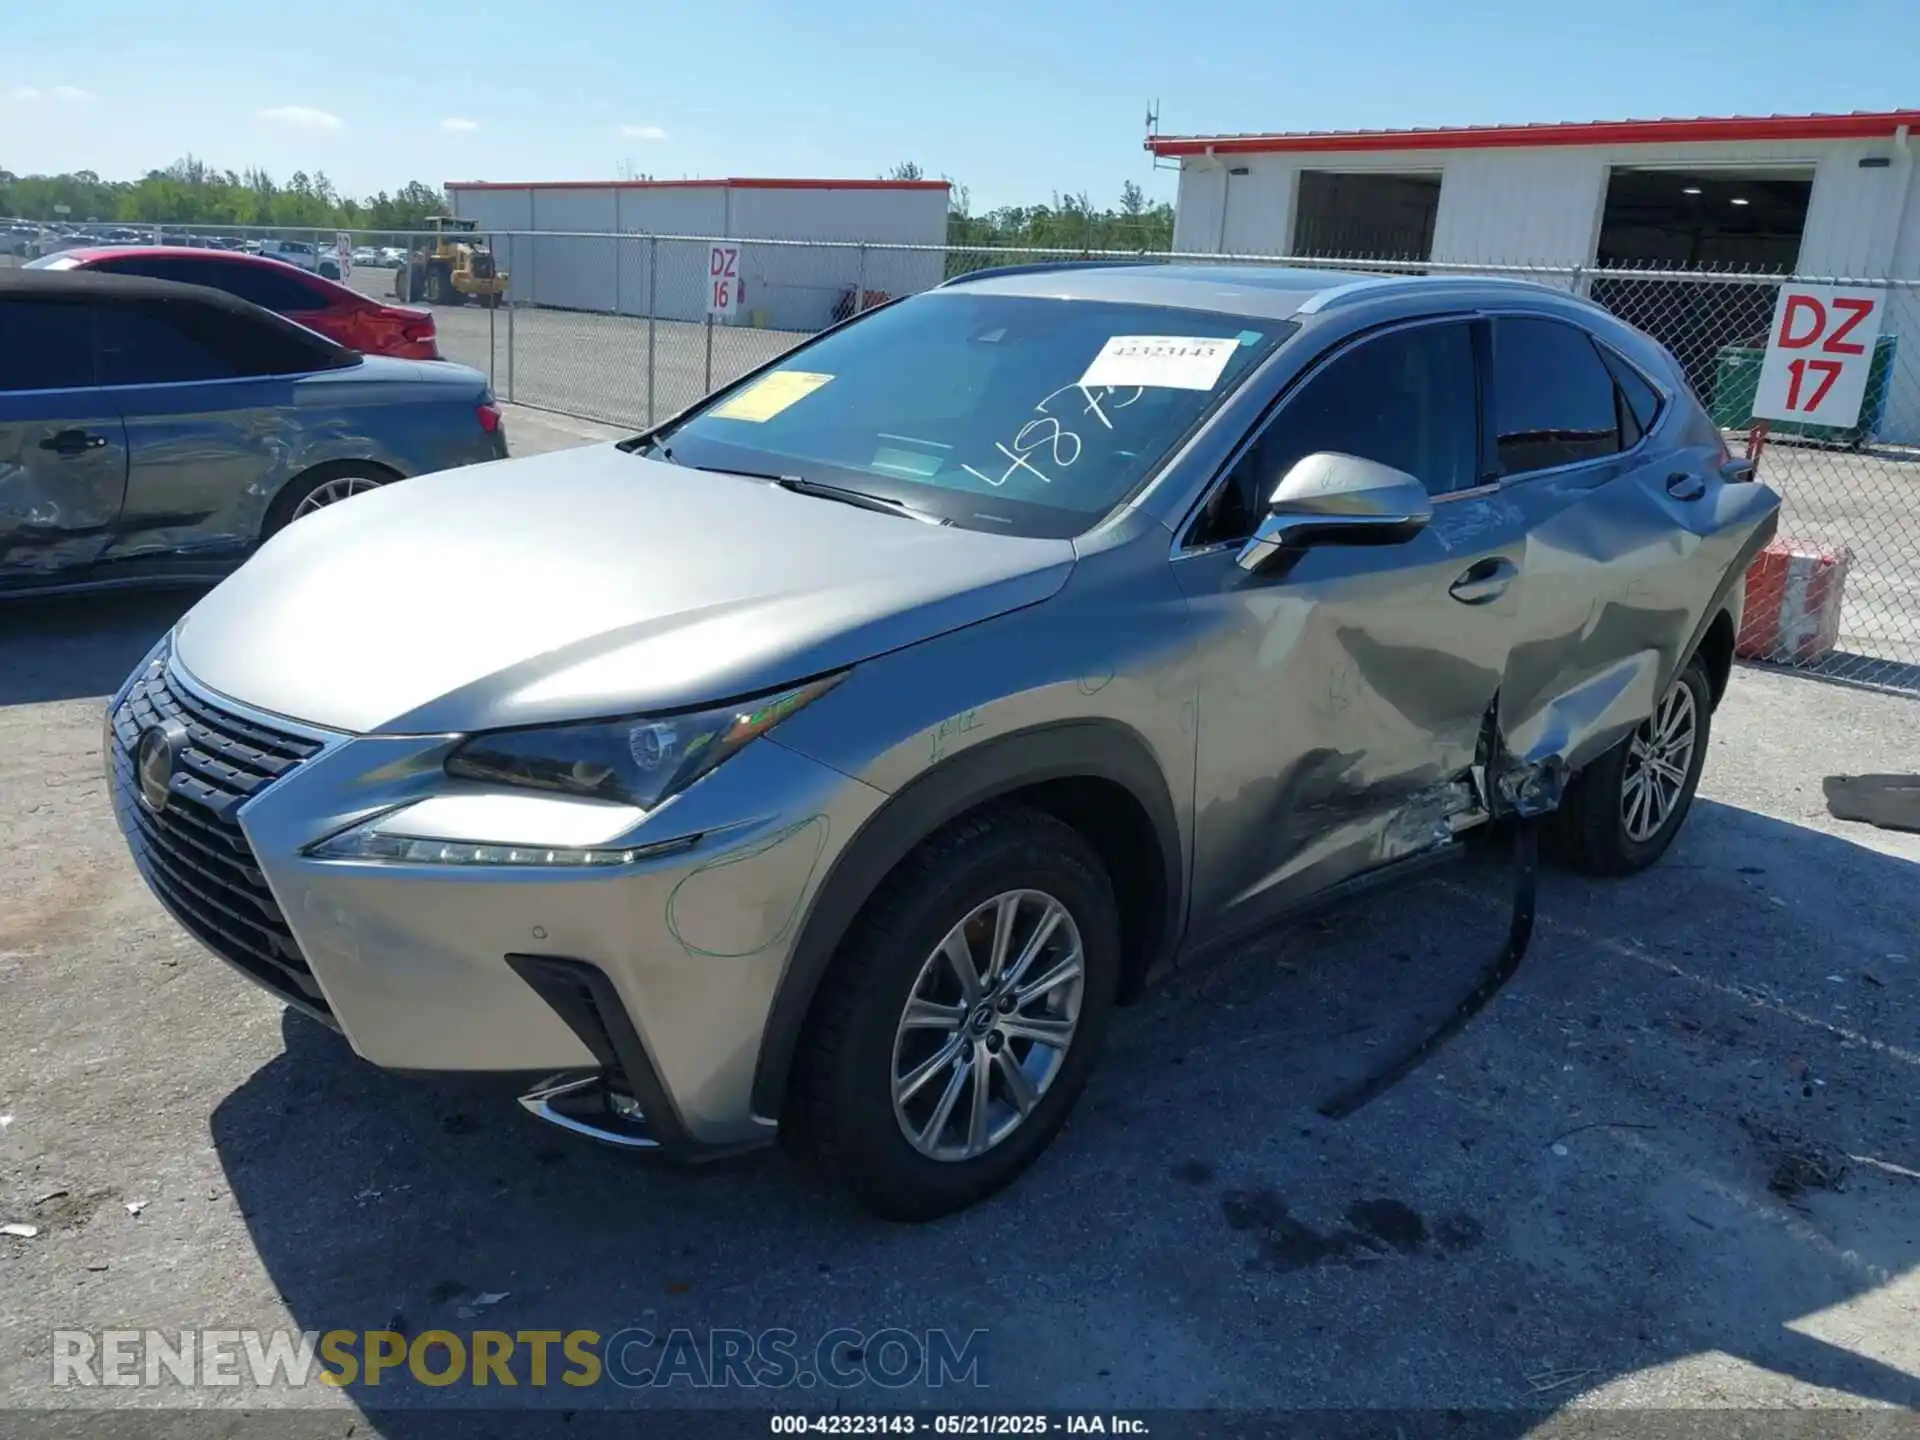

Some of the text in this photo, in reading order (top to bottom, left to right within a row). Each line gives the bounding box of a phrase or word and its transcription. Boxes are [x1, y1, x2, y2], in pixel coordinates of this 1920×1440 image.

[711, 247, 738, 278] DZ
[713, 281, 729, 308] 16
[1778, 294, 1875, 356] DZ
[1785, 358, 1843, 413] 17
